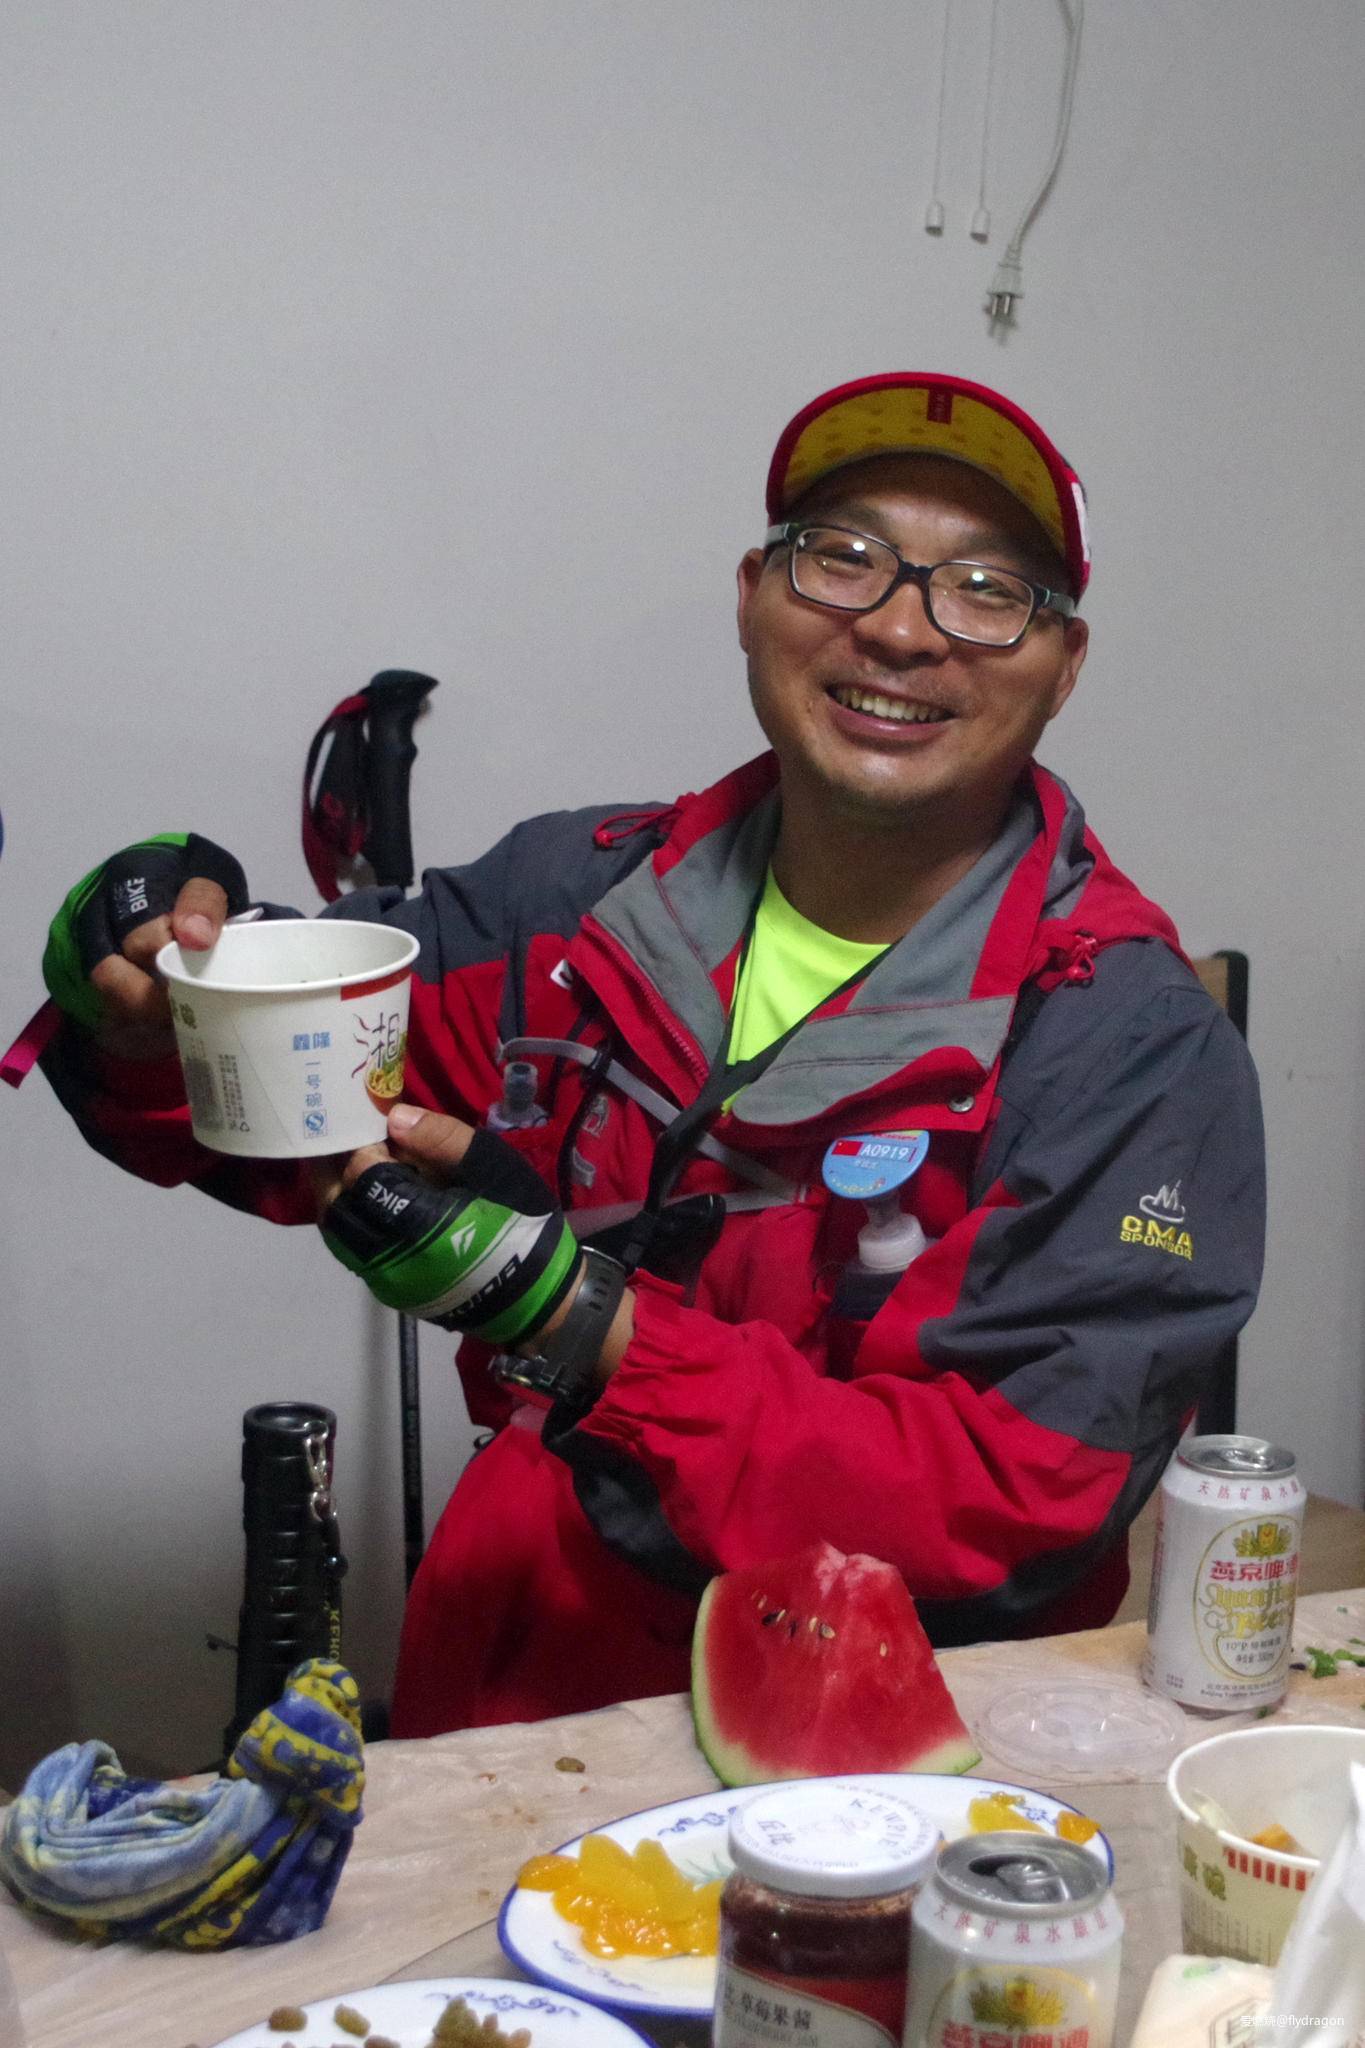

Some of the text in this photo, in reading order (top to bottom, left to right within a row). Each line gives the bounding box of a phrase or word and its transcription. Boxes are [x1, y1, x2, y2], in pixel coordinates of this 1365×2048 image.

[127, 877, 148, 913] BIKE
[860, 1143, 910, 1160] A0919
[367, 1181, 411, 1216] BIKE
[1120, 1230, 1193, 1261] SPONSOR
[1122, 1215, 1193, 1251] CMA
[757, 1819, 796, 1845] 丘比
[849, 1798, 907, 1847] KEWPIE
